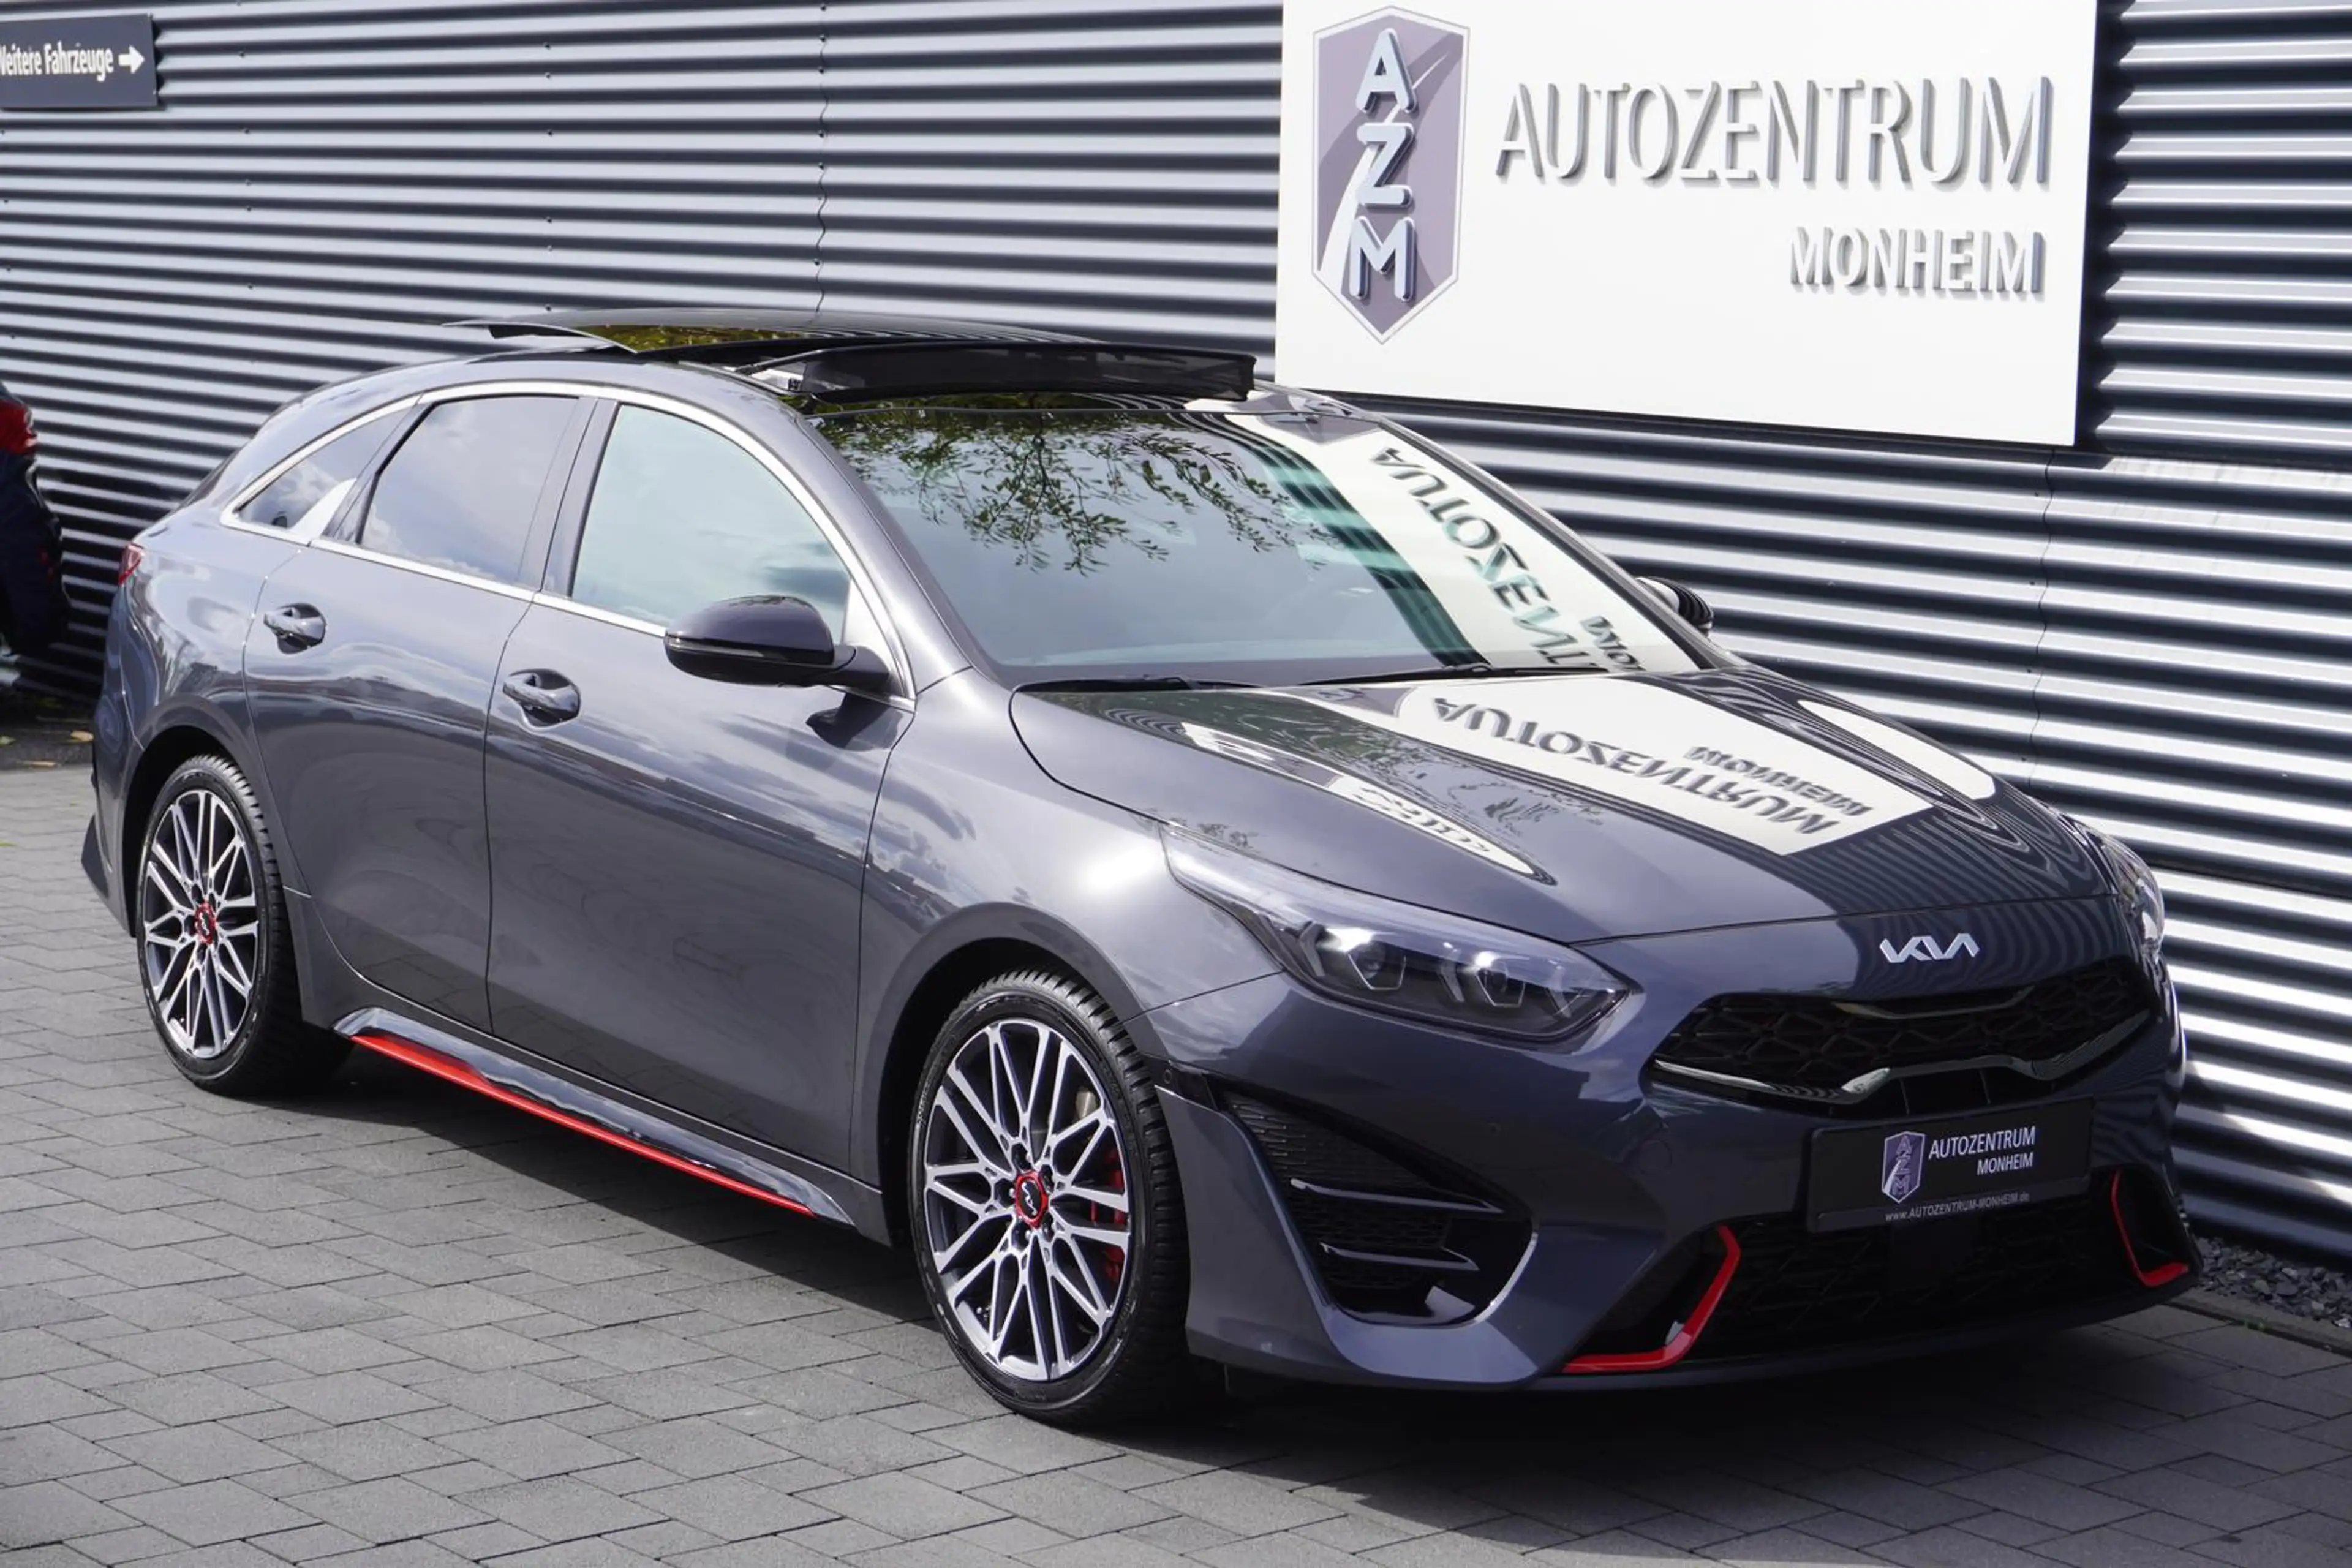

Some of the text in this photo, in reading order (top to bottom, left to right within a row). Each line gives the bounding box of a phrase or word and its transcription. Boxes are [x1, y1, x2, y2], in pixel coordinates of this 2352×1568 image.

[43, 40, 114, 82] Fahrzeuge
[1496, 75, 2054, 186] AUTOZENTRUM
[1790, 227, 2046, 296] MONHEIM
[1879, 932, 1981, 964] KIA
[1928, 1126, 2036, 1161] AUTOZENTRUM
[1976, 1152, 2034, 1176] MONHEIM
[1885, 1192, 2030, 1222] www.AUTOZENTRUM-MONHEIM.de
